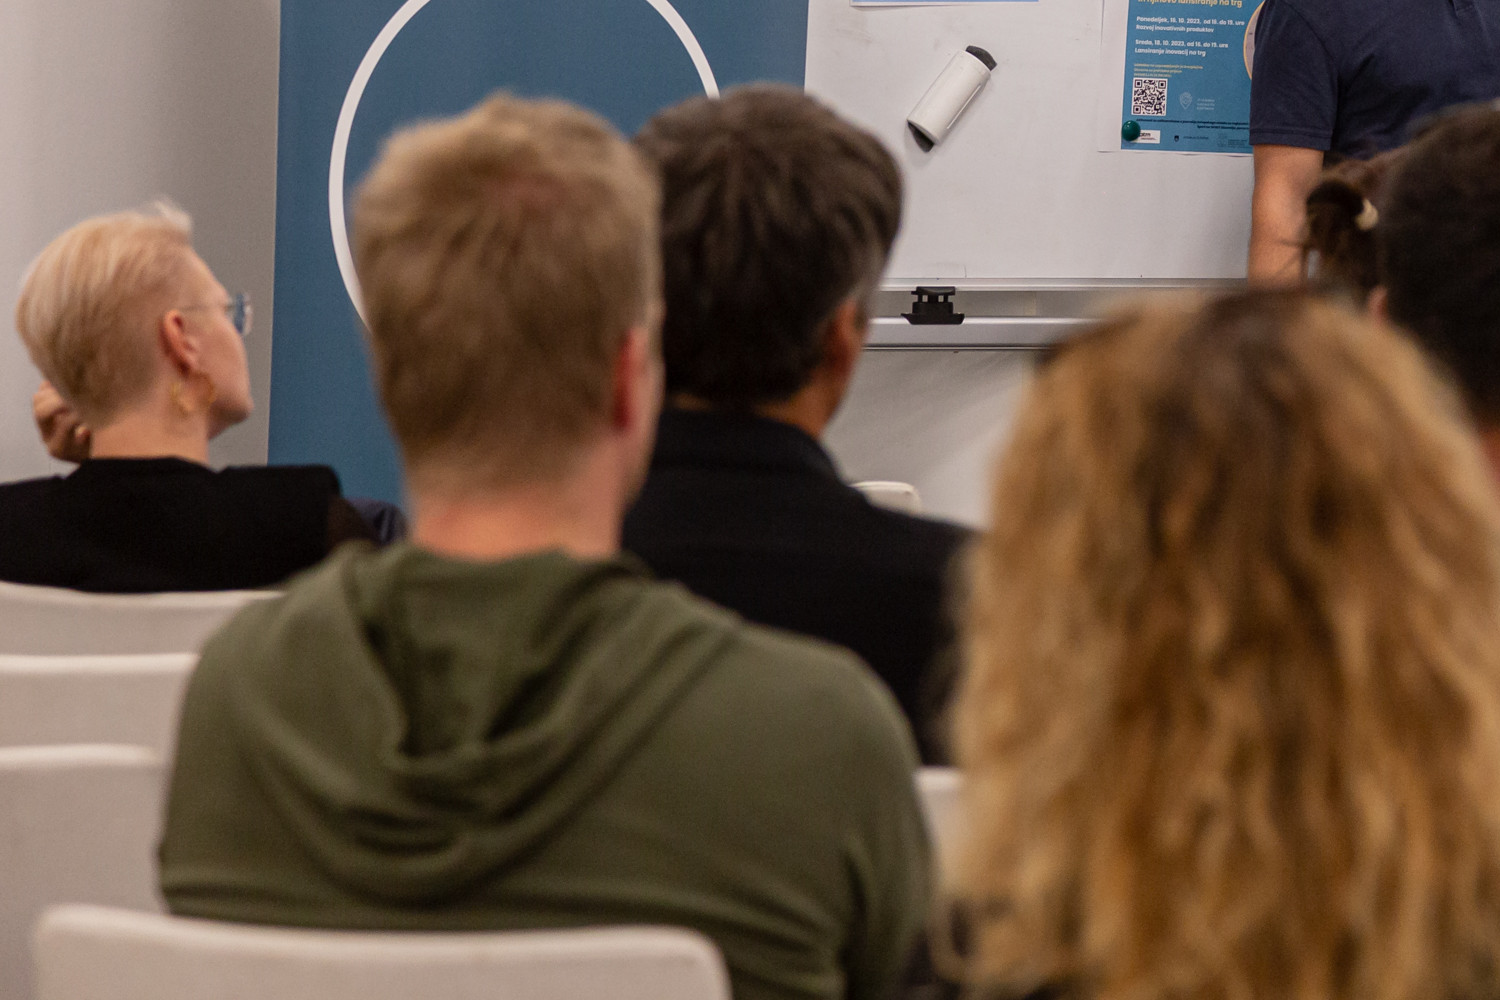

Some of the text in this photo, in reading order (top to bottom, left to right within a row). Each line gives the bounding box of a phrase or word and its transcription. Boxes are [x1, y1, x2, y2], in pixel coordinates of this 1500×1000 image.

[1136, 24, 1154, 32] Razvoj
[1135, 47, 1164, 55] Lansiranje
[1165, 48, 1188, 56] inovacij
